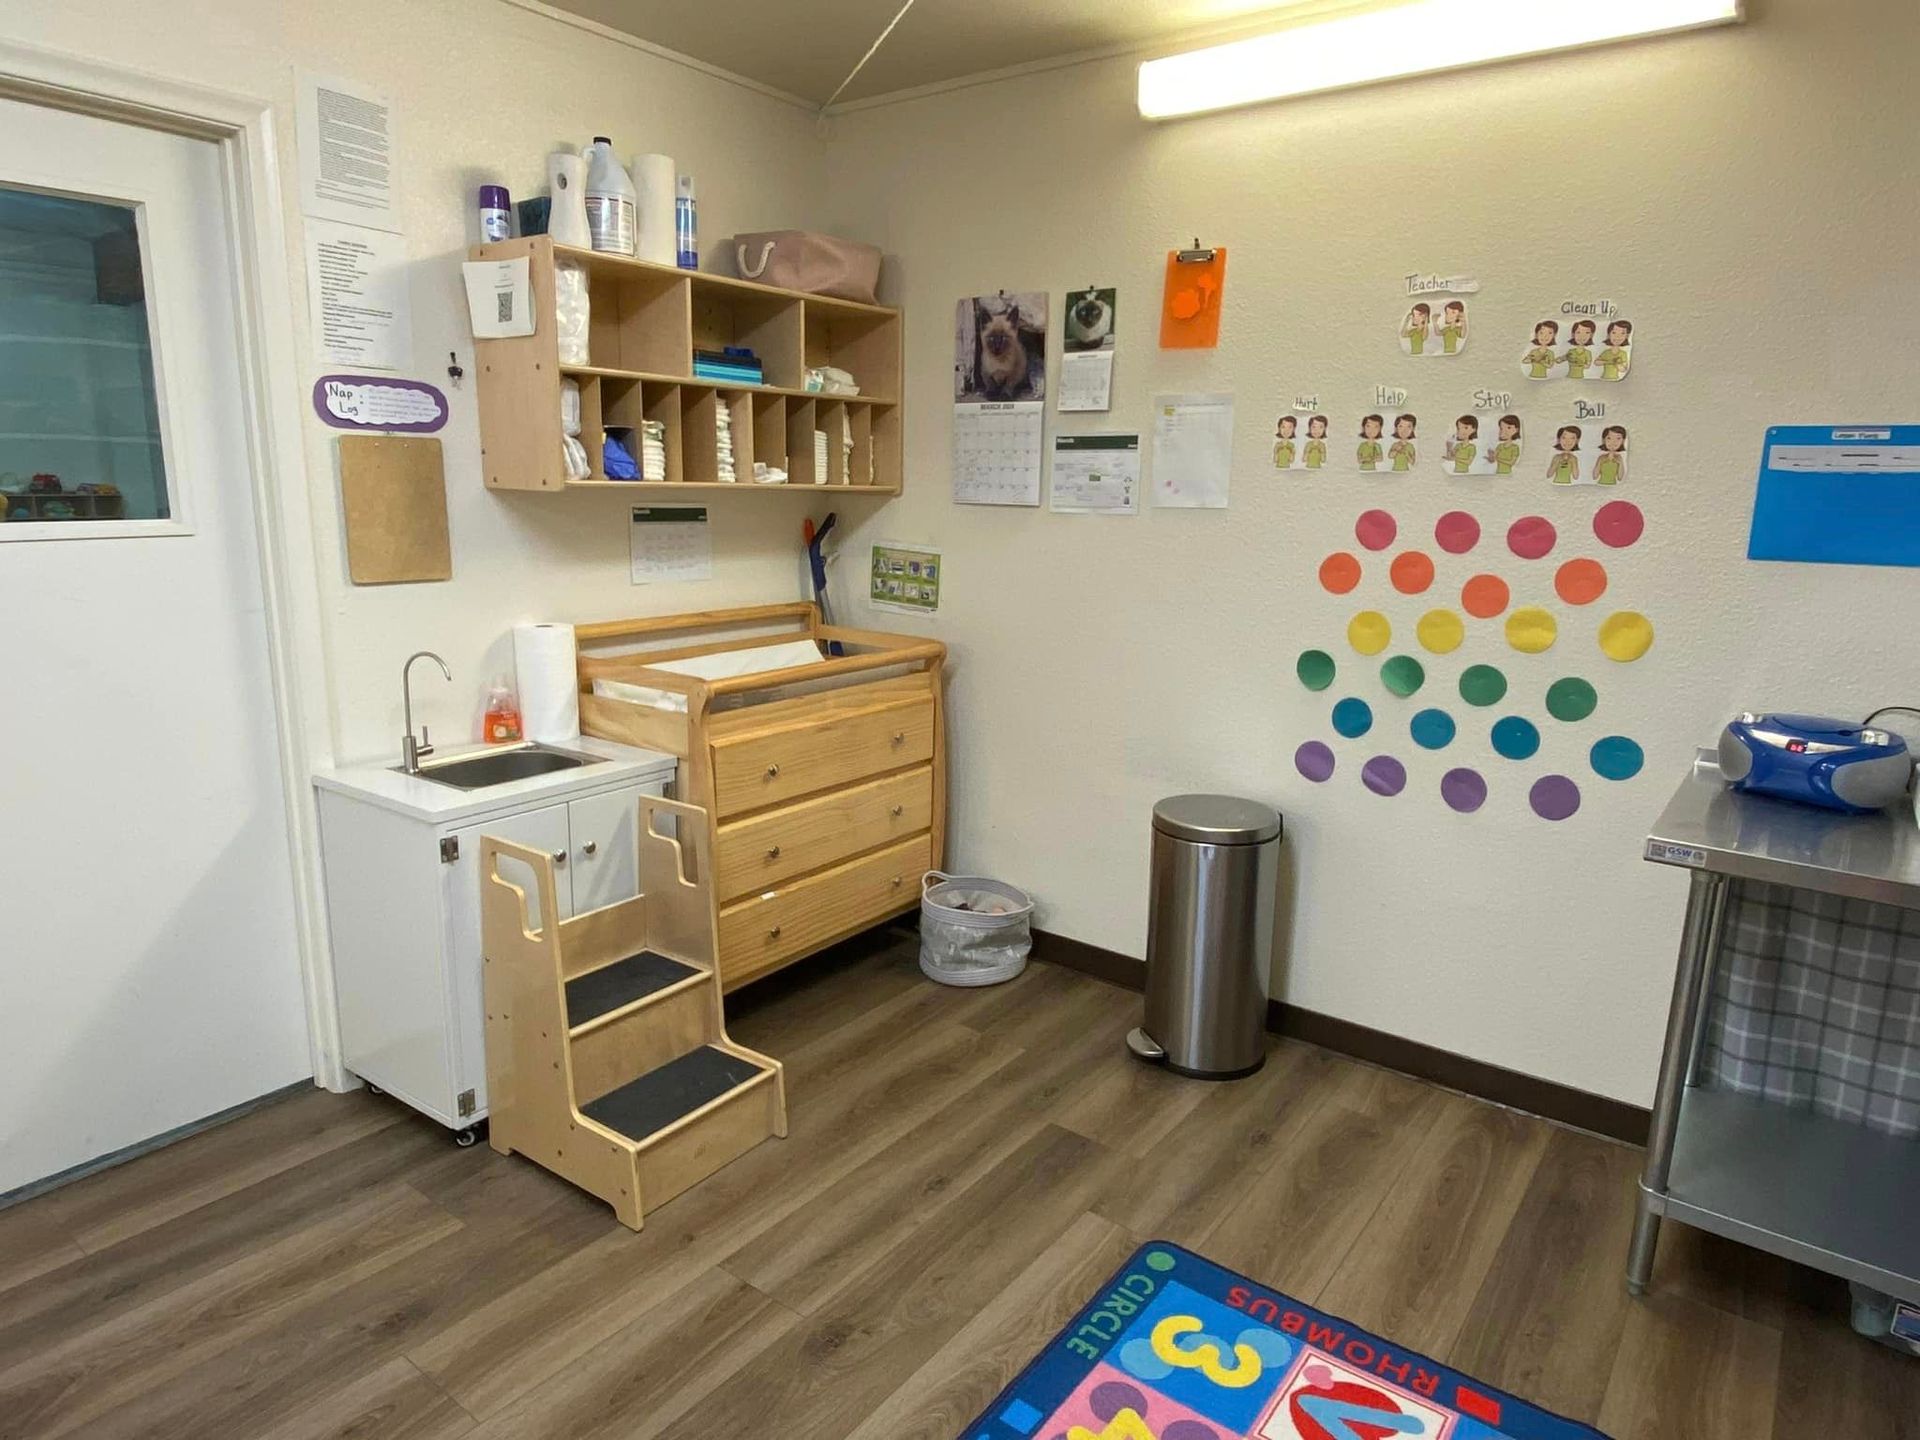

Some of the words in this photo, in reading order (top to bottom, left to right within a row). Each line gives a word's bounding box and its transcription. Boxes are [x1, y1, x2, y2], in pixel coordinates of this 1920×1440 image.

[1405, 273, 1452, 294] Teacher
[1560, 301, 1596, 315] Clean
[1601, 300, 1617, 318] Up
[329, 383, 353, 400] Nap
[1375, 386, 1405, 406] Help
[1473, 389, 1510, 410] Stop
[1295, 396, 1318, 411] Hurt
[1574, 400, 1605, 419] Ball
[1668, 846, 1693, 857] GSW
[1066, 1274, 1155, 1360] CIRCLE
[1151, 1315, 1262, 1388] 3
[1226, 1286, 1440, 1397] RHOMBUS
